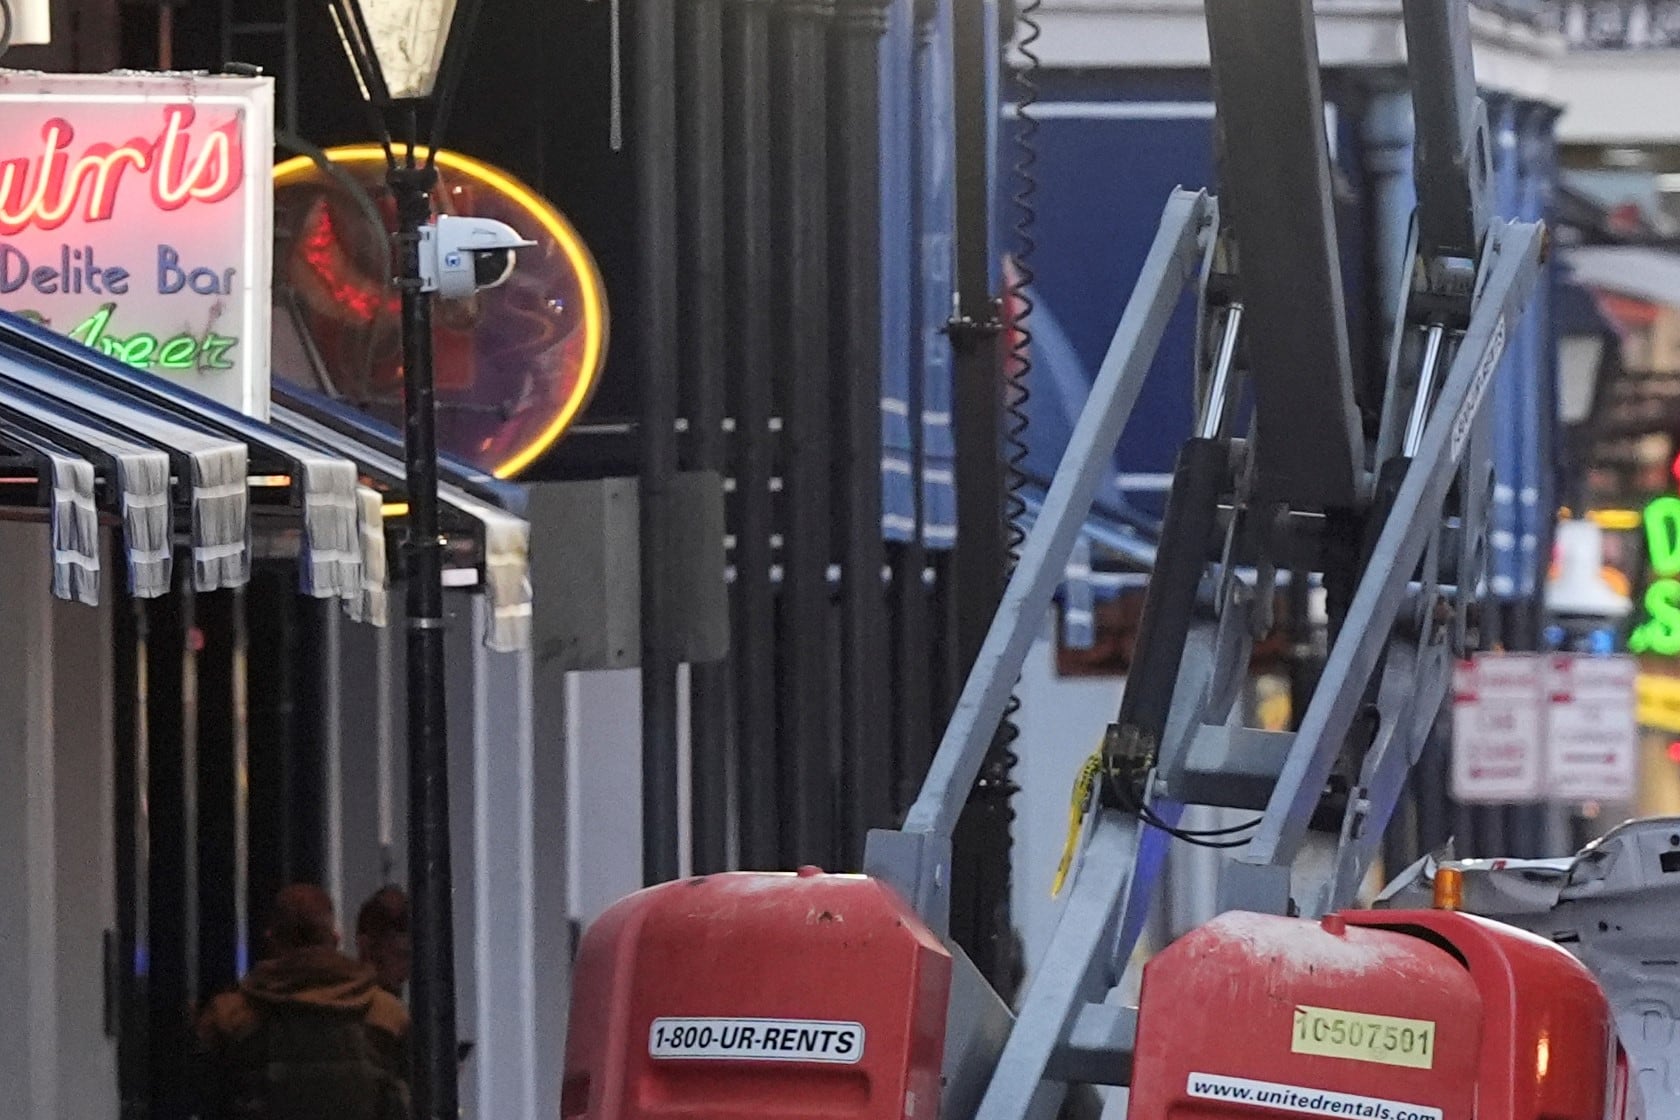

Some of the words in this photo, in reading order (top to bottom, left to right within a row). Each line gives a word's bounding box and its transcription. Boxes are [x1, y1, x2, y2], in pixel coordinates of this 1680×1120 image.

[0, 243, 130, 294] Delite
[157, 244, 236, 295] Bar
[655, 1026, 855, 1054] 1-800-UR-RENTS
[1296, 1016, 1429, 1055] 10507501
